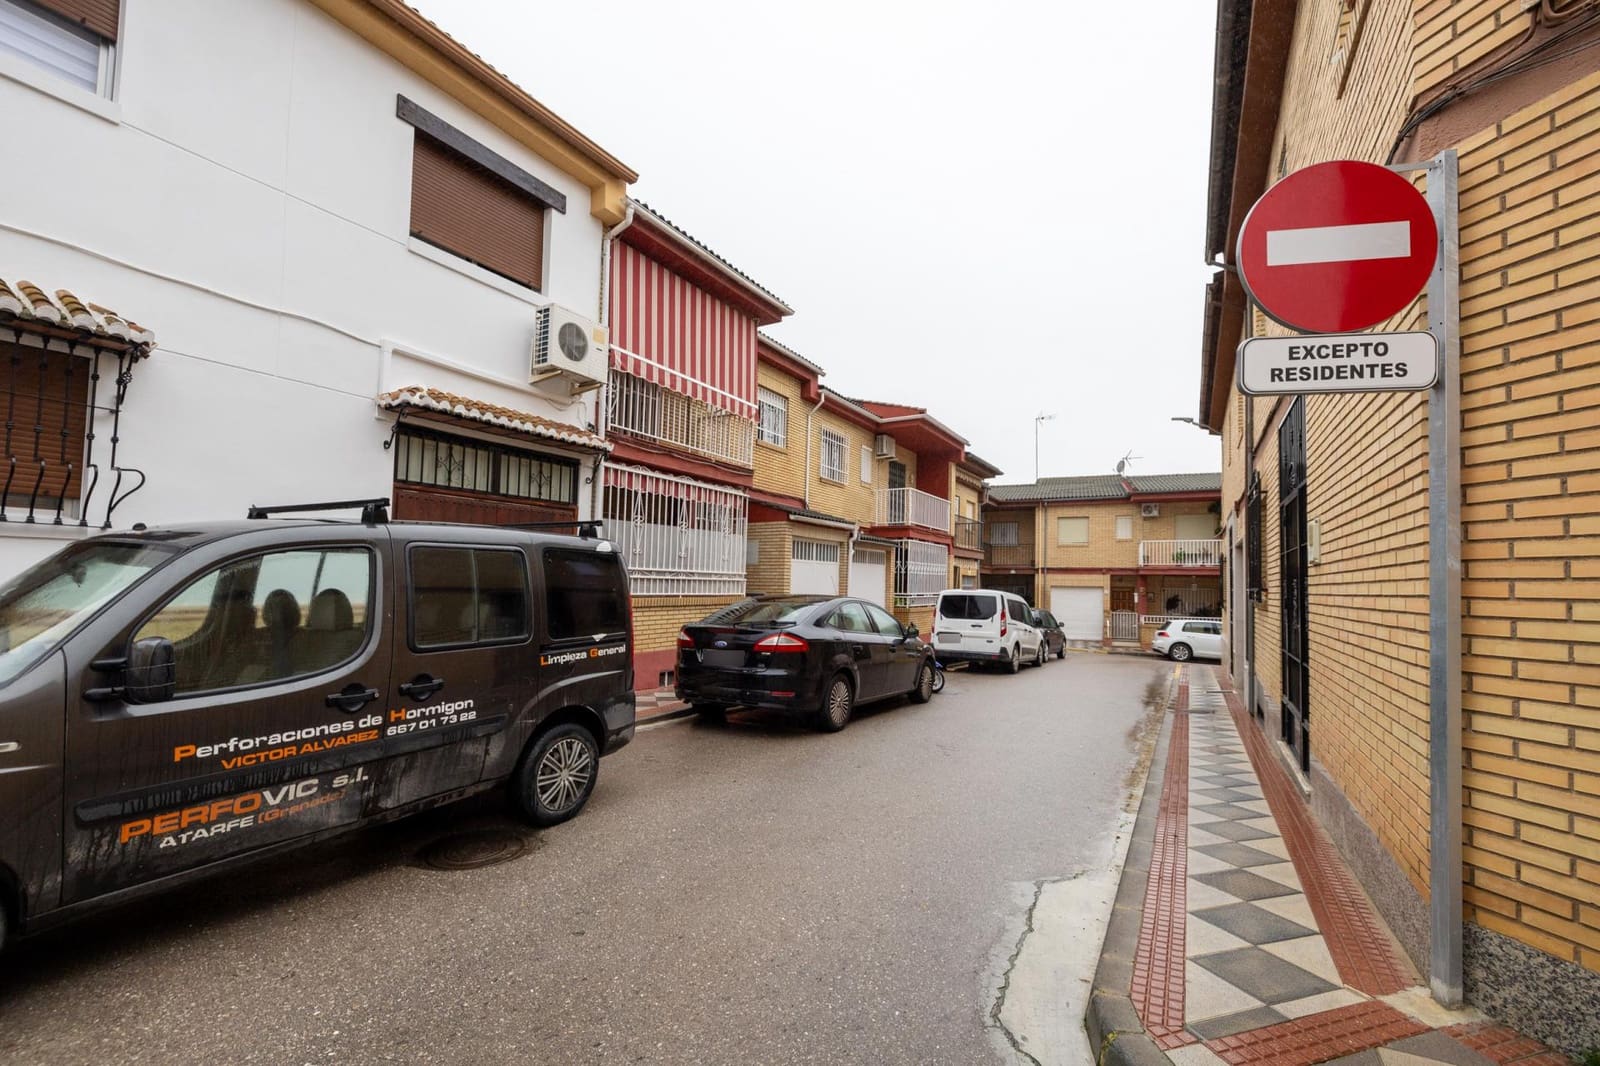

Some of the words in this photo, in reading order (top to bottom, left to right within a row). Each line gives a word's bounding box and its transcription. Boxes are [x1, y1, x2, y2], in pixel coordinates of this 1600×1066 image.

[1288, 341, 1388, 361] EXCEPTO
[1270, 362, 1408, 382] RESIDENTES
[541, 651, 587, 666] Limpieza
[590, 644, 626, 658] General
[174, 720, 354, 762] Perforaciones
[358, 714, 383, 728] de
[390, 699, 474, 722] Hormigon
[419, 719, 436, 729] 01
[440, 714, 458, 725] 73
[459, 711, 477, 722] 22
[221, 746, 297, 769] VICTOR
[300, 729, 379, 754] ALVAREZ
[119, 778, 319, 845] PERFOVIC
[159, 815, 255, 848] ATARFE
